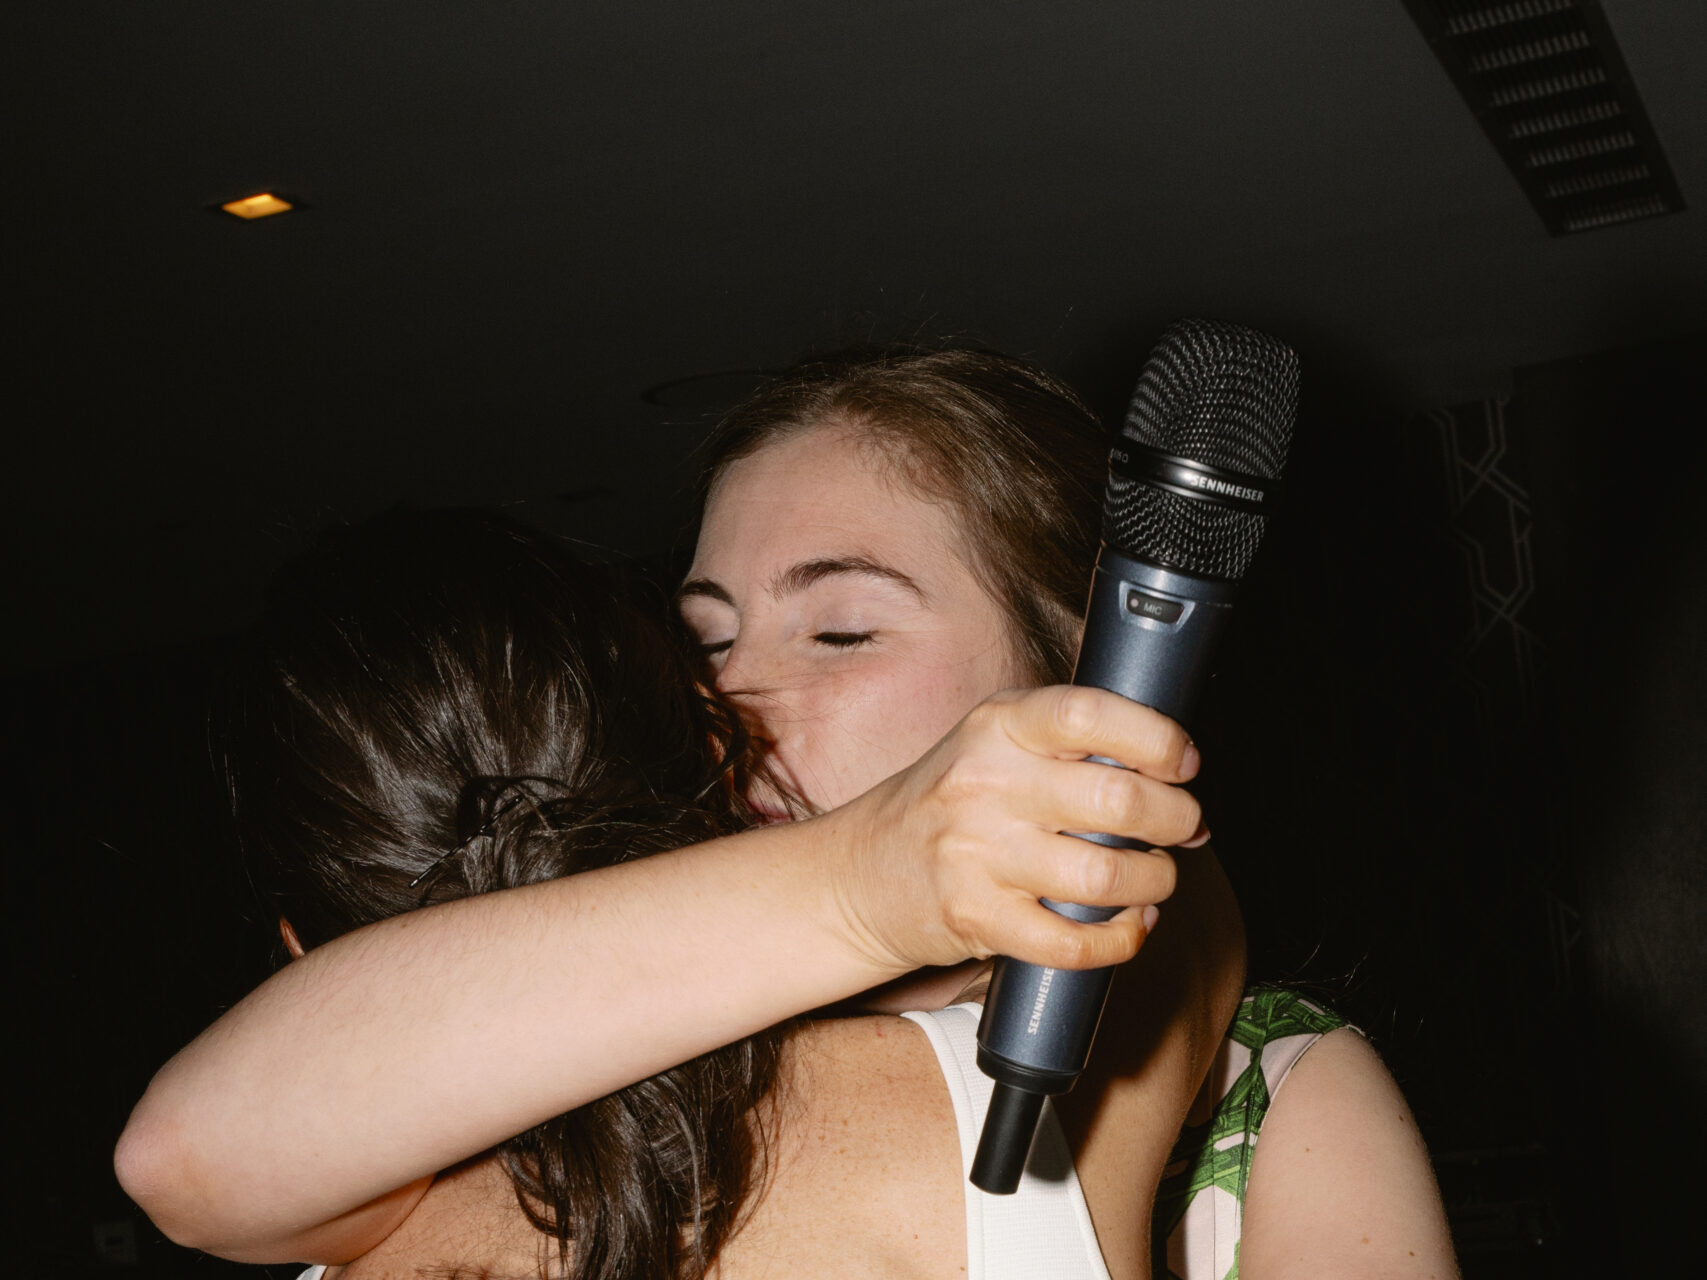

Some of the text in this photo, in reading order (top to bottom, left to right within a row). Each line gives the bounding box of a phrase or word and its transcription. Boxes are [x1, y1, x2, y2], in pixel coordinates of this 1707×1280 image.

[1190, 474, 1264, 502] SENNHEISER
[1144, 603, 1163, 616] MIC
[1027, 967, 1055, 1035] SENNHEISE
